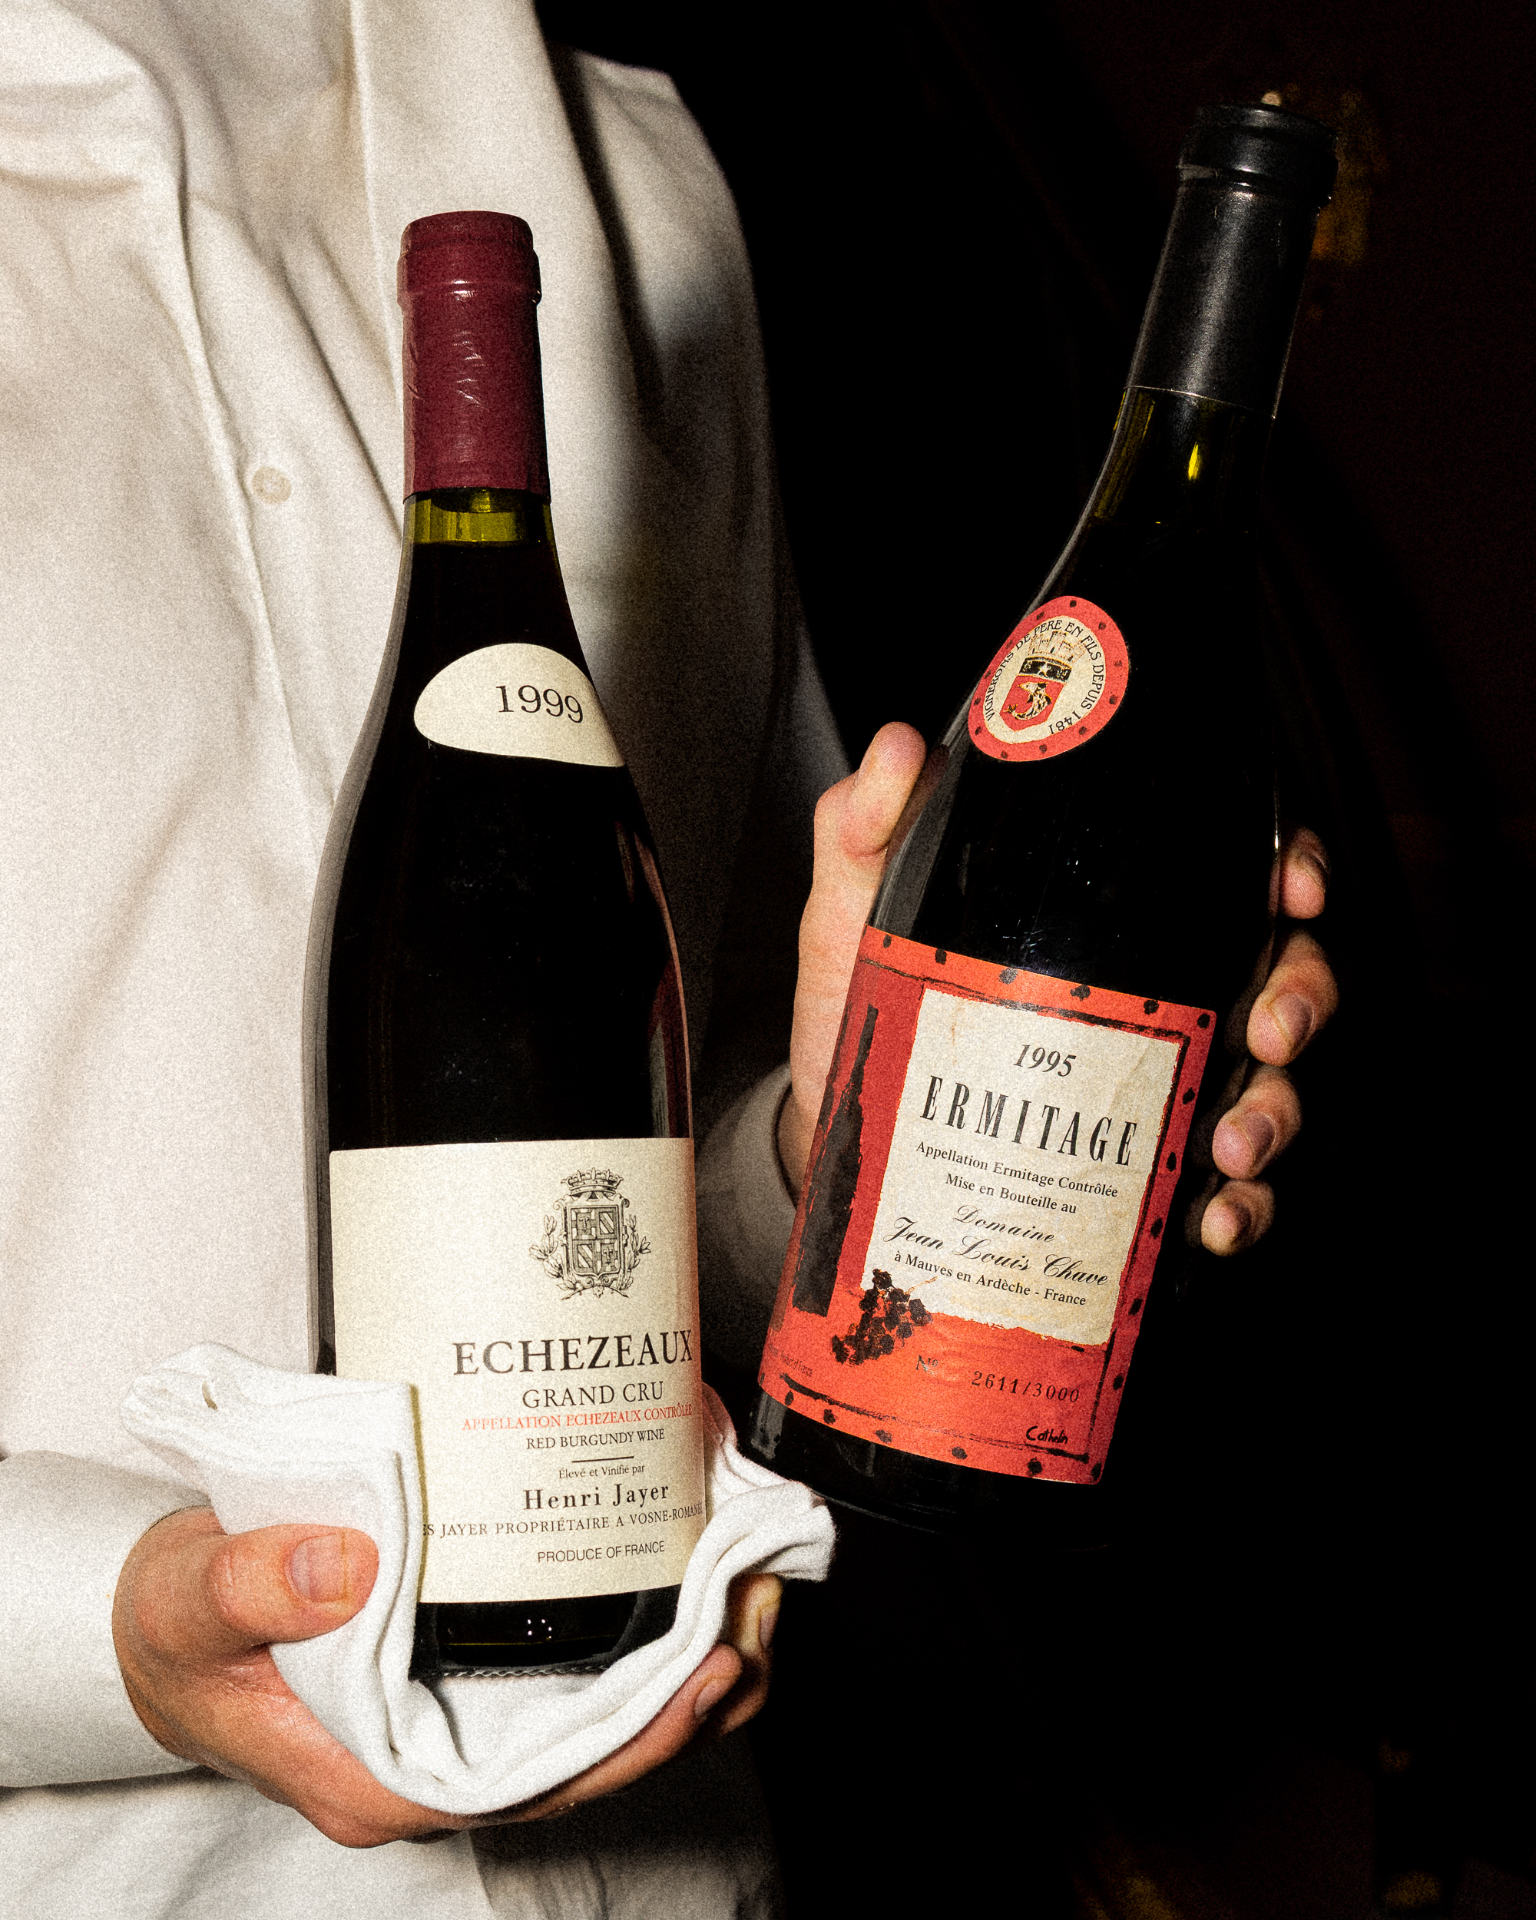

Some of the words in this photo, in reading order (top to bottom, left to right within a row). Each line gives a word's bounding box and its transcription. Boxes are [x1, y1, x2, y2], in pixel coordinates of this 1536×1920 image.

[1015, 633, 1031, 650] DE
[1033, 620, 1062, 638] PERE
[1065, 622, 1084, 638] EN
[1081, 635, 1102, 661] FILS
[985, 652, 1014, 721] VIGNERONS
[1080, 664, 1105, 710] DEPUIS
[495, 684, 584, 724] 1999
[1048, 710, 1082, 736] 1481
[1013, 1044, 1077, 1077] 1995
[919, 1074, 1138, 1167] ERMITAGE
[916, 1141, 989, 1171] Appellation
[992, 1161, 1055, 1188] Ermitage
[1058, 1176, 1119, 1198] Contrôlée
[945, 1173, 975, 1191] Mise
[979, 1184, 995, 1196] en
[999, 1187, 1057, 1210] Bouteille
[1060, 1203, 1077, 1214] au
[953, 1204, 1055, 1243] Domaine
[883, 1216, 944, 1250] Jean
[952, 1235, 1032, 1272] Louis
[1043, 1254, 1110, 1286] Chave
[894, 1250, 902, 1263] à
[905, 1253, 953, 1277] Mauves
[956, 1271, 972, 1283] en
[976, 1276, 1031, 1296] Ardèche
[1043, 1288, 1087, 1306] France
[452, 1329, 696, 1376] ECHEZEAUX
[522, 1385, 615, 1408] GRAND
[622, 1381, 664, 1402] CRU
[971, 1370, 1080, 1403] 2611/3000
[461, 1414, 561, 1431] APPELLATION
[566, 1409, 642, 1426] ECHEZEAUX
[526, 1437, 556, 1450] RED
[559, 1431, 635, 1449] BURGUNDY
[636, 1428, 665, 1442] WINE
[559, 1466, 587, 1480] Élevé
[589, 1469, 599, 1478] et
[601, 1464, 630, 1476] Vinifié
[632, 1465, 646, 1479] par
[523, 1486, 602, 1510] Henri
[612, 1483, 670, 1508] Jayer
[440, 1523, 488, 1539] JAYER
[495, 1516, 610, 1536] PROPRIÉTAIRE
[615, 1515, 625, 1528] A
[538, 1547, 603, 1564] PRODUCE
[606, 1545, 623, 1559] OF
[625, 1540, 666, 1557] FRANCE
